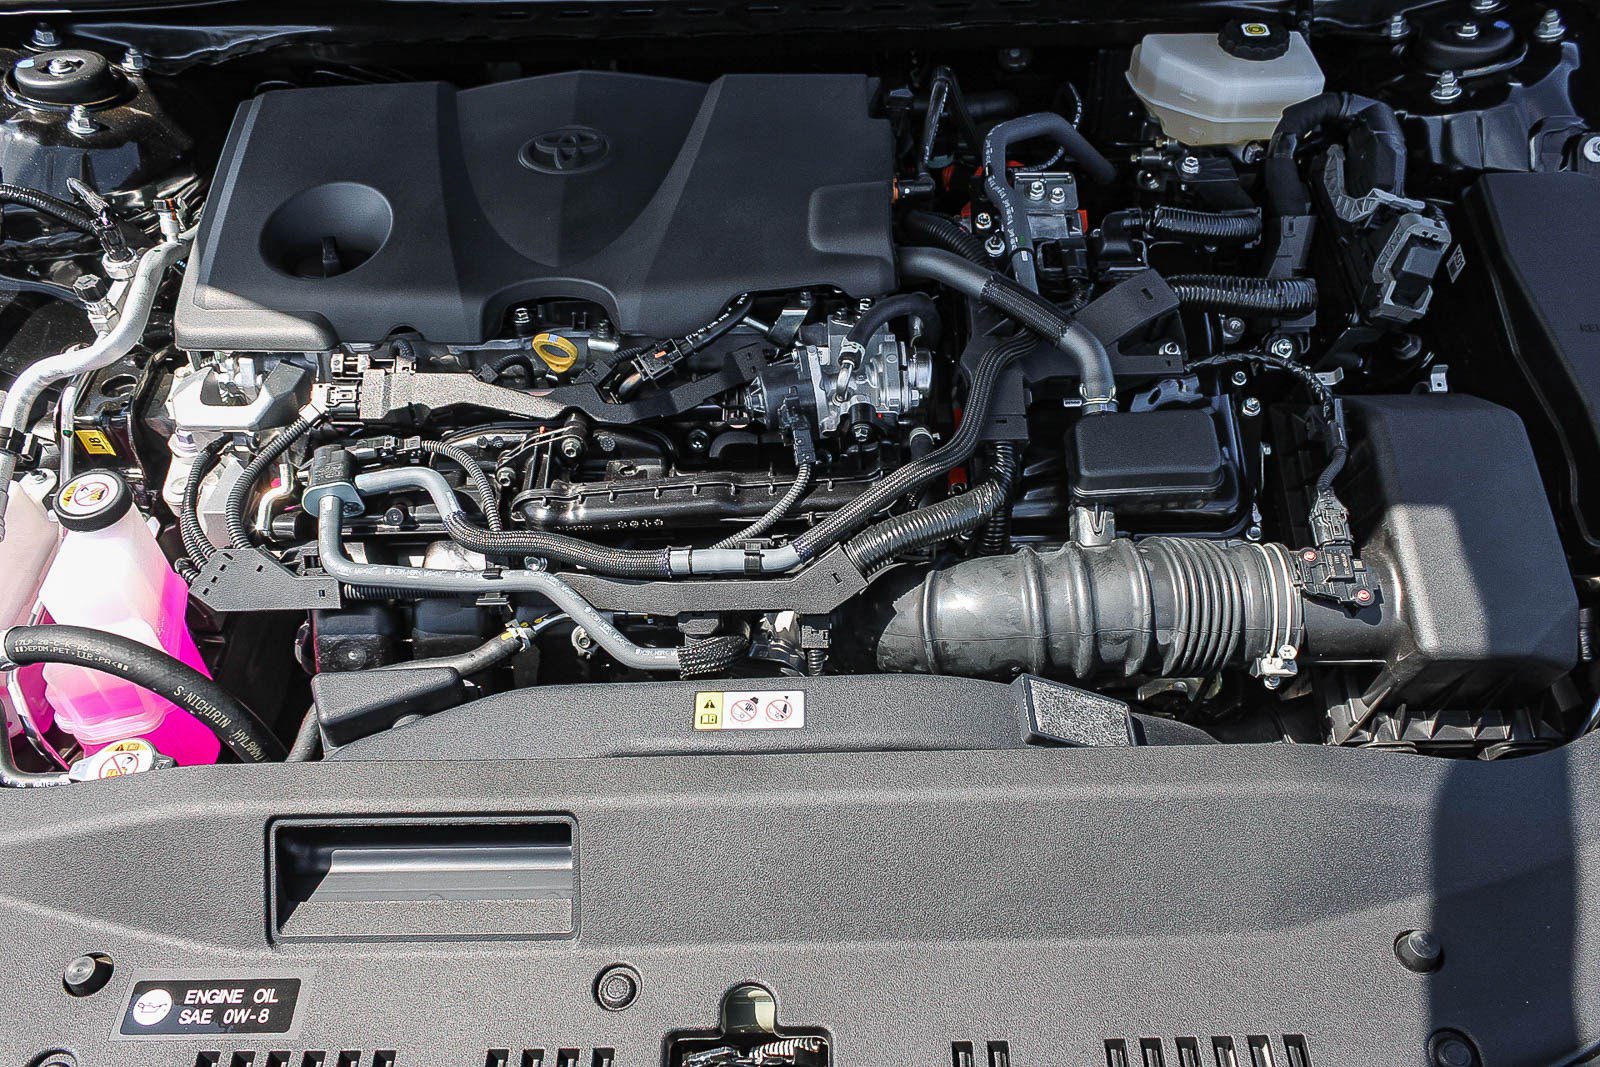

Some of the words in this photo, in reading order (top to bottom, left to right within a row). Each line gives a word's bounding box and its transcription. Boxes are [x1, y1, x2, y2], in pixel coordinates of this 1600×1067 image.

[184, 989, 245, 1004] ENGINE
[253, 988, 279, 1004] OIL
[178, 1009, 214, 1025] SAE
[223, 1008, 270, 1025] 0W-8
